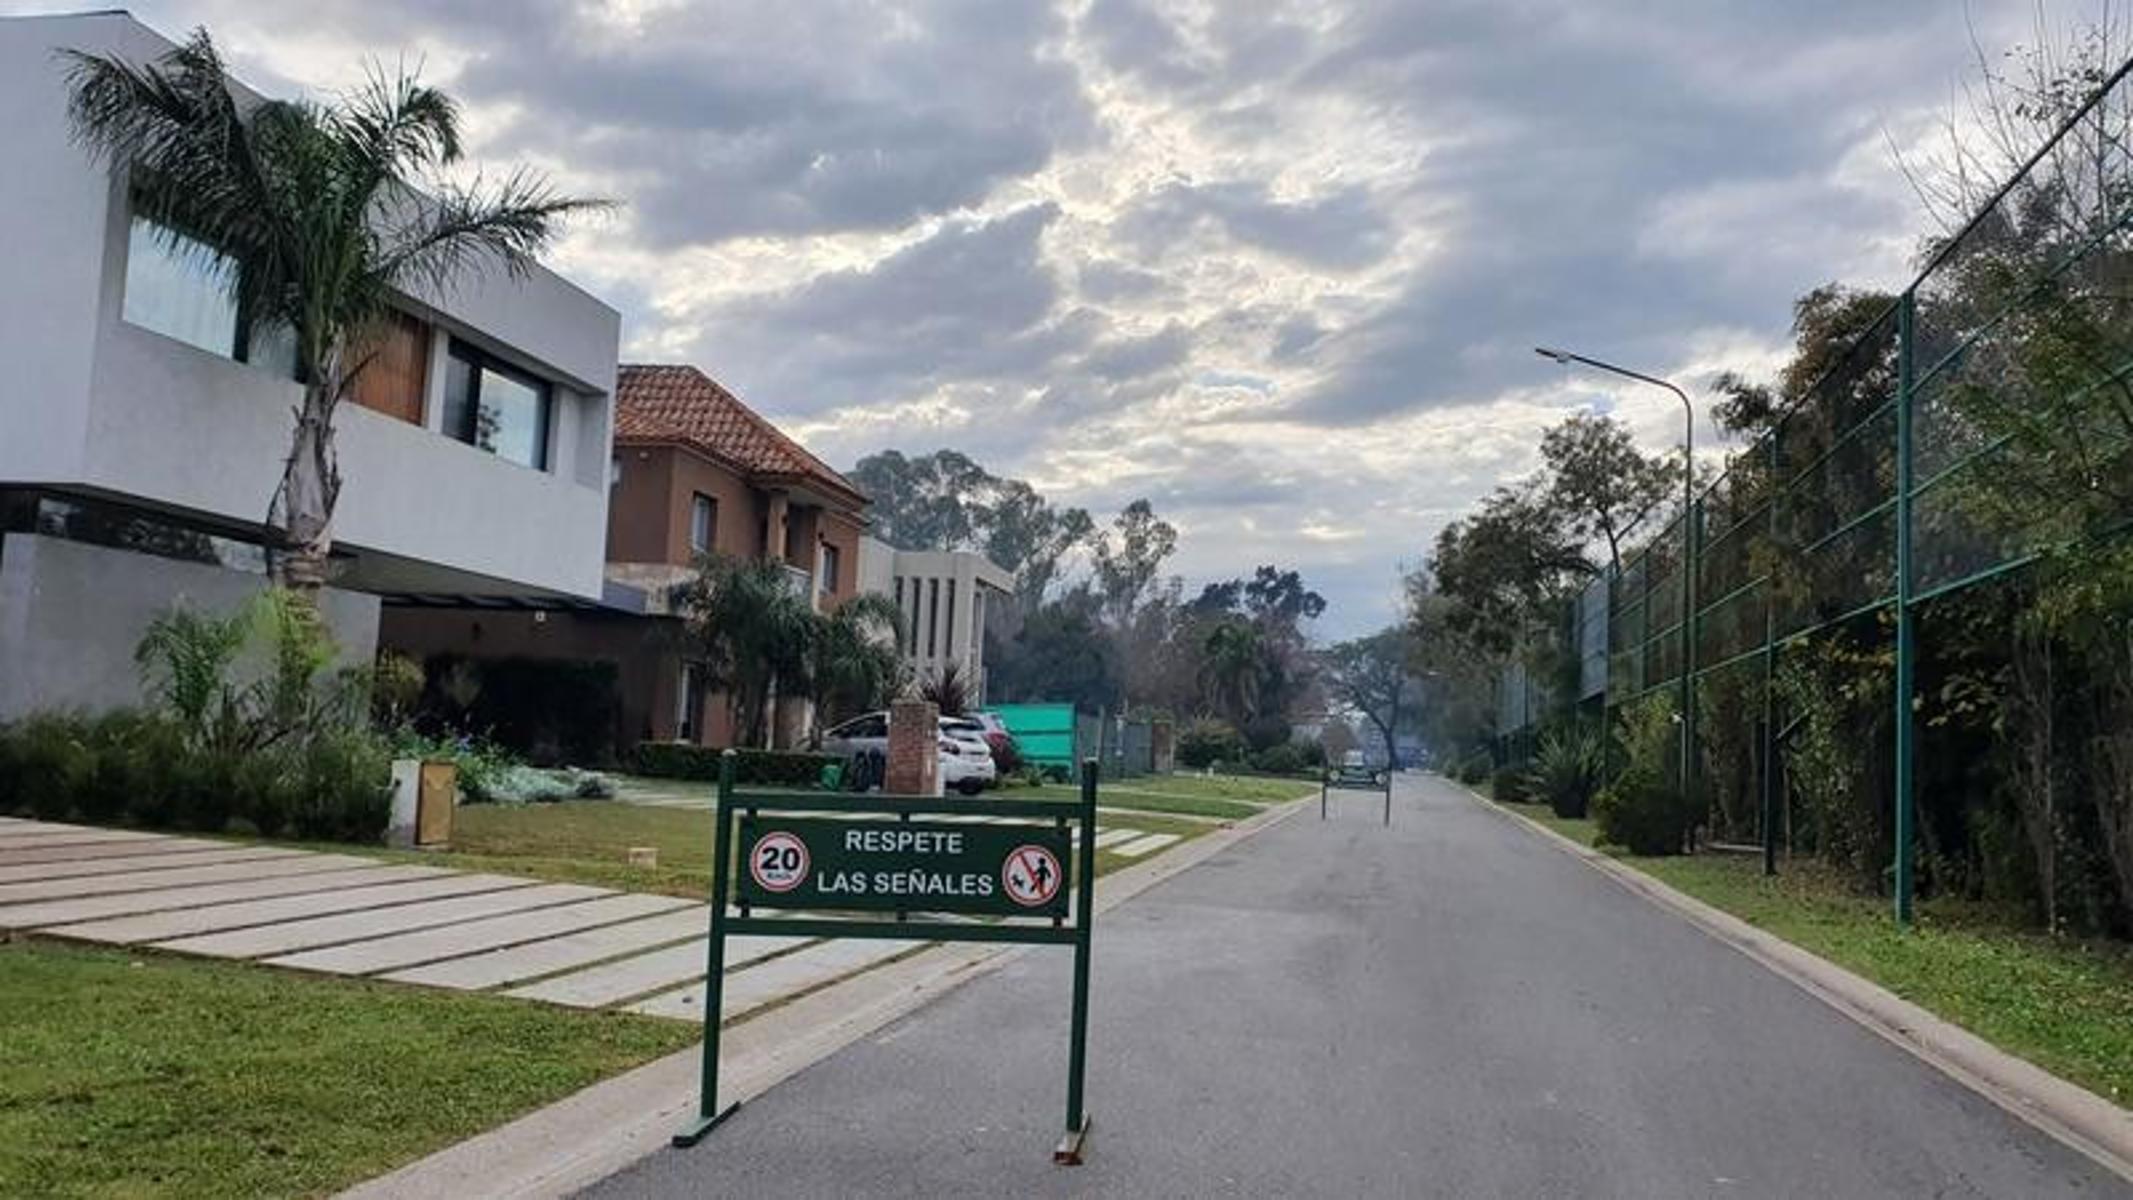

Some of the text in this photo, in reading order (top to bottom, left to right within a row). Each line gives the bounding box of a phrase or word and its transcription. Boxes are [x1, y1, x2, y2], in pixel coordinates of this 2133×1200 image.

[845, 830, 964, 854] RESPETE
[761, 847, 800, 870] 20
[818, 868, 993, 896] LAS SEÑALES
